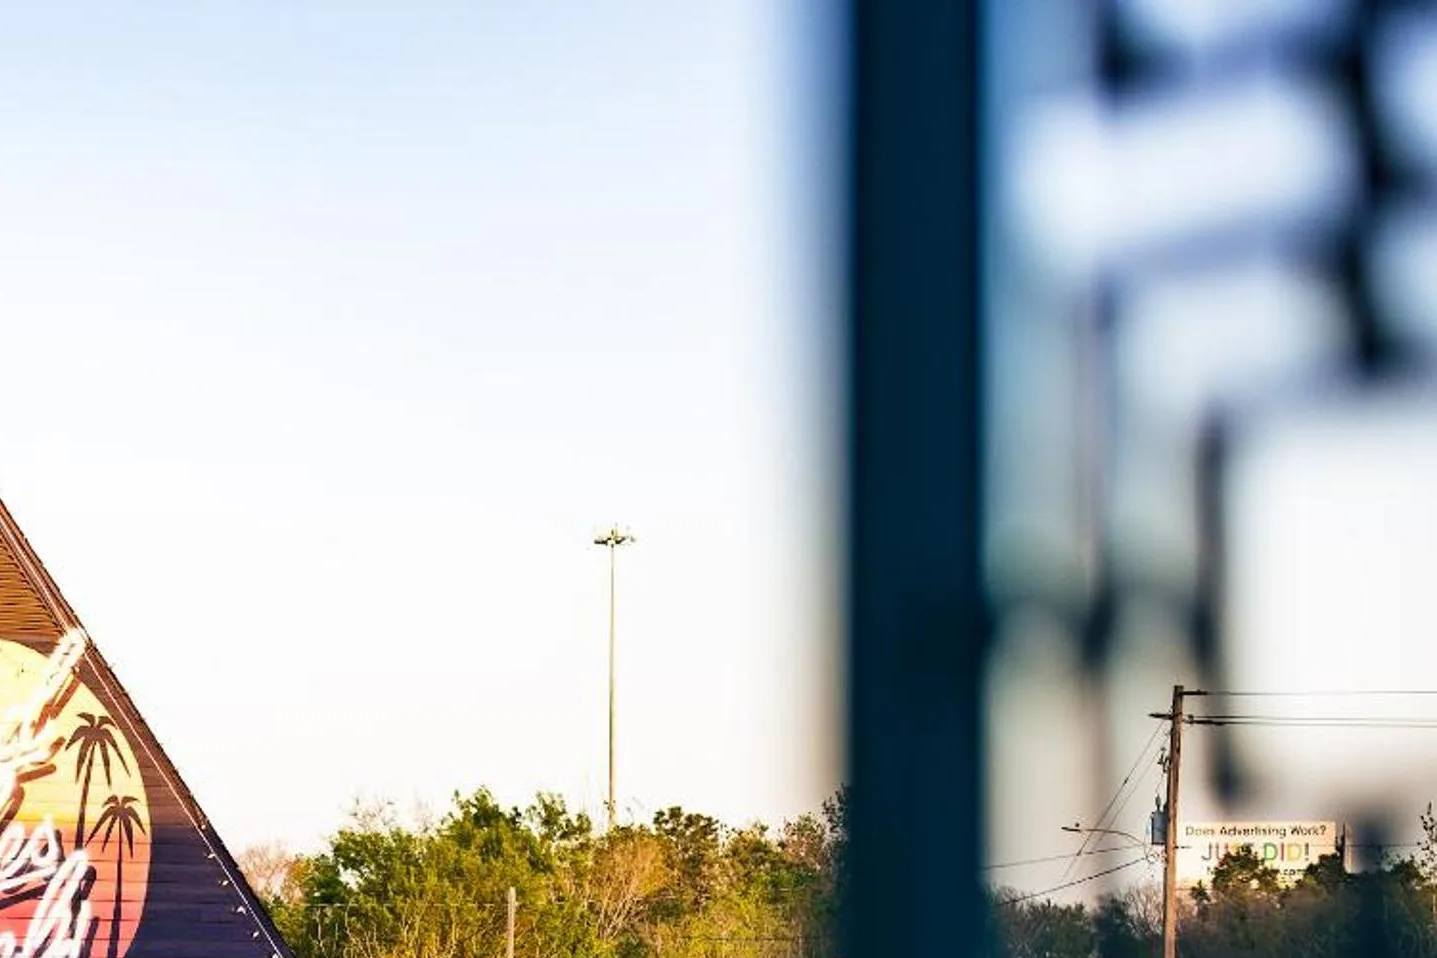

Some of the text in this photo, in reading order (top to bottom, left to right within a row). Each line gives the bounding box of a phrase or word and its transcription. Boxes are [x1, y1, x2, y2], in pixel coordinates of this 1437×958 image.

[1185, 824, 1327, 839] Does Advertising Work?
[1263, 841, 1310, 862] DID!
